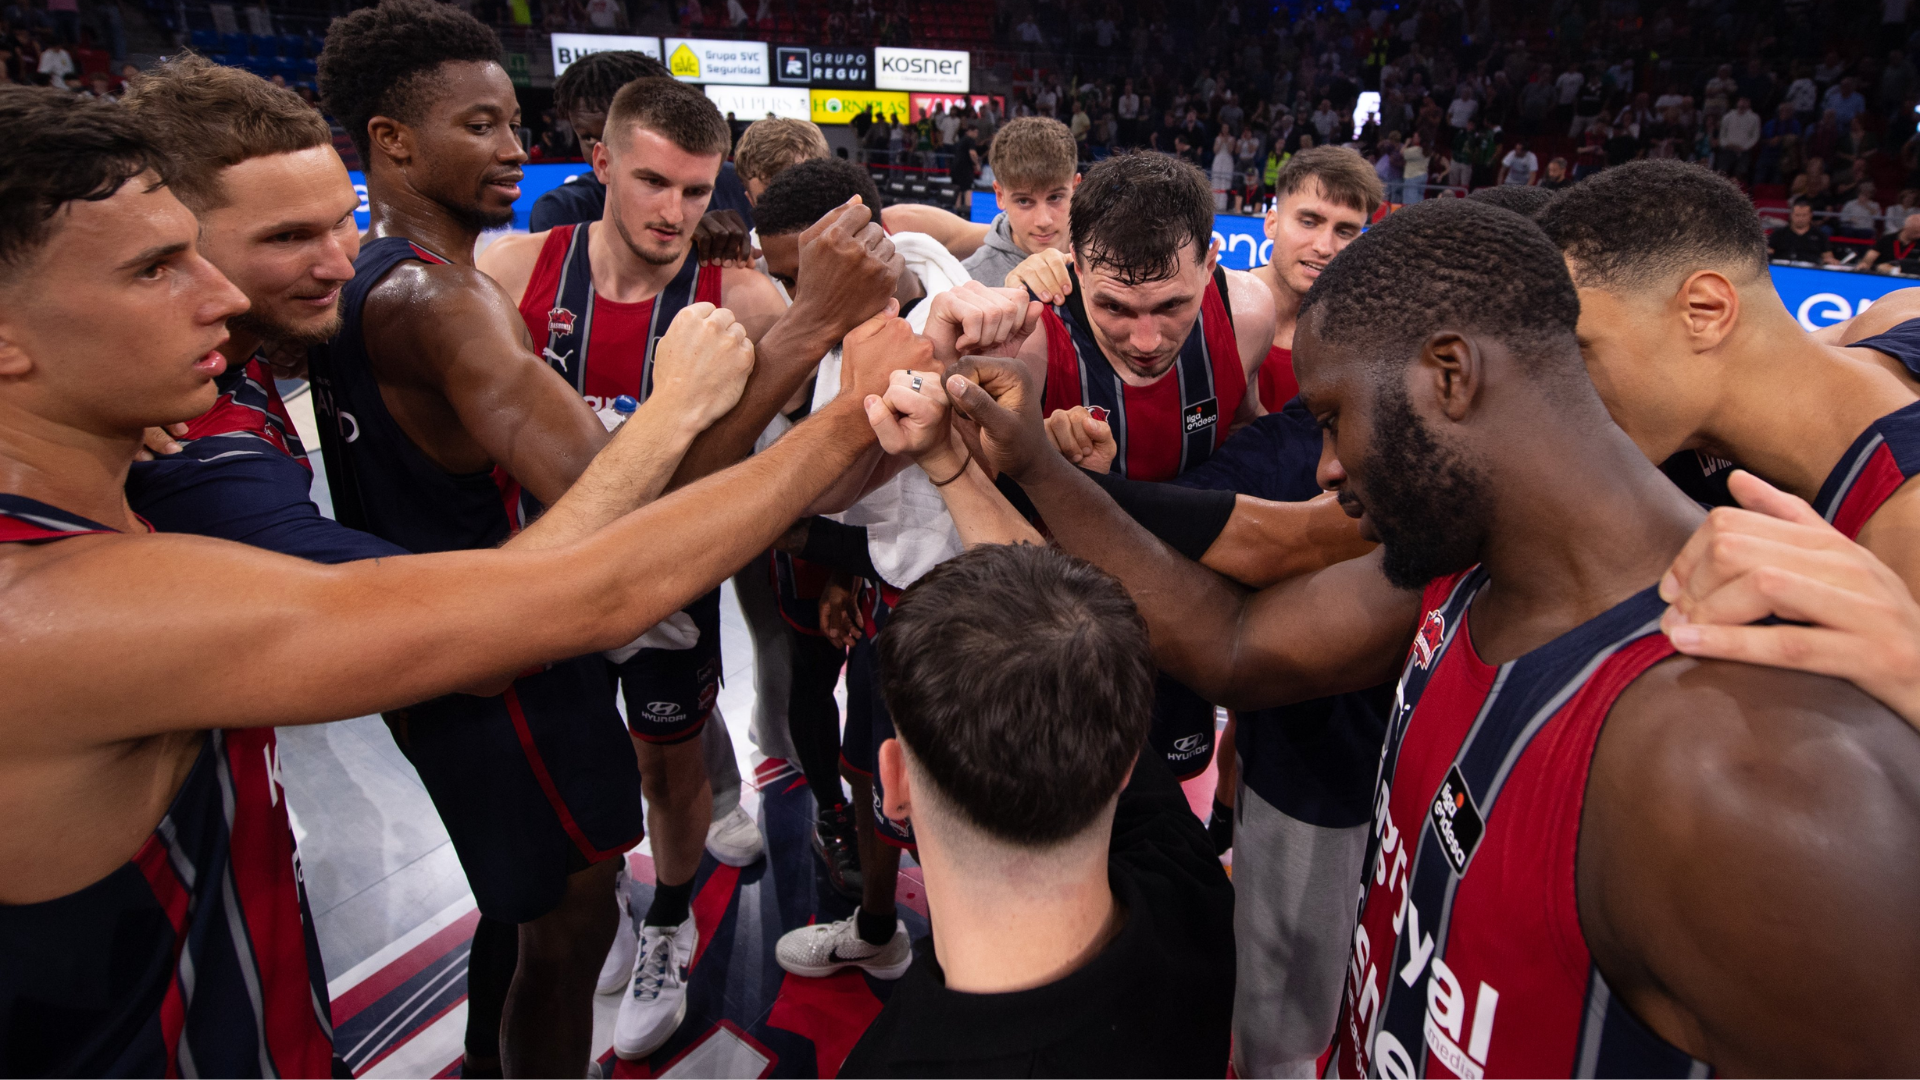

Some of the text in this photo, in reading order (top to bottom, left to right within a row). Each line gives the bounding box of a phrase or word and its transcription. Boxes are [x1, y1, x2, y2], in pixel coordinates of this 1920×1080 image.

[705, 51, 760, 61] Grupo SVC
[812, 52, 867, 66] GRUPO
[706, 64, 761, 75] Seguridad
[813, 67, 867, 80] REGUI
[1186, 413, 1202, 424] liga
[1187, 414, 1217, 430] endesa
[1441, 782, 1457, 819] liga
[1434, 800, 1466, 868] endesa
[1427, 1026, 1476, 1079] media
